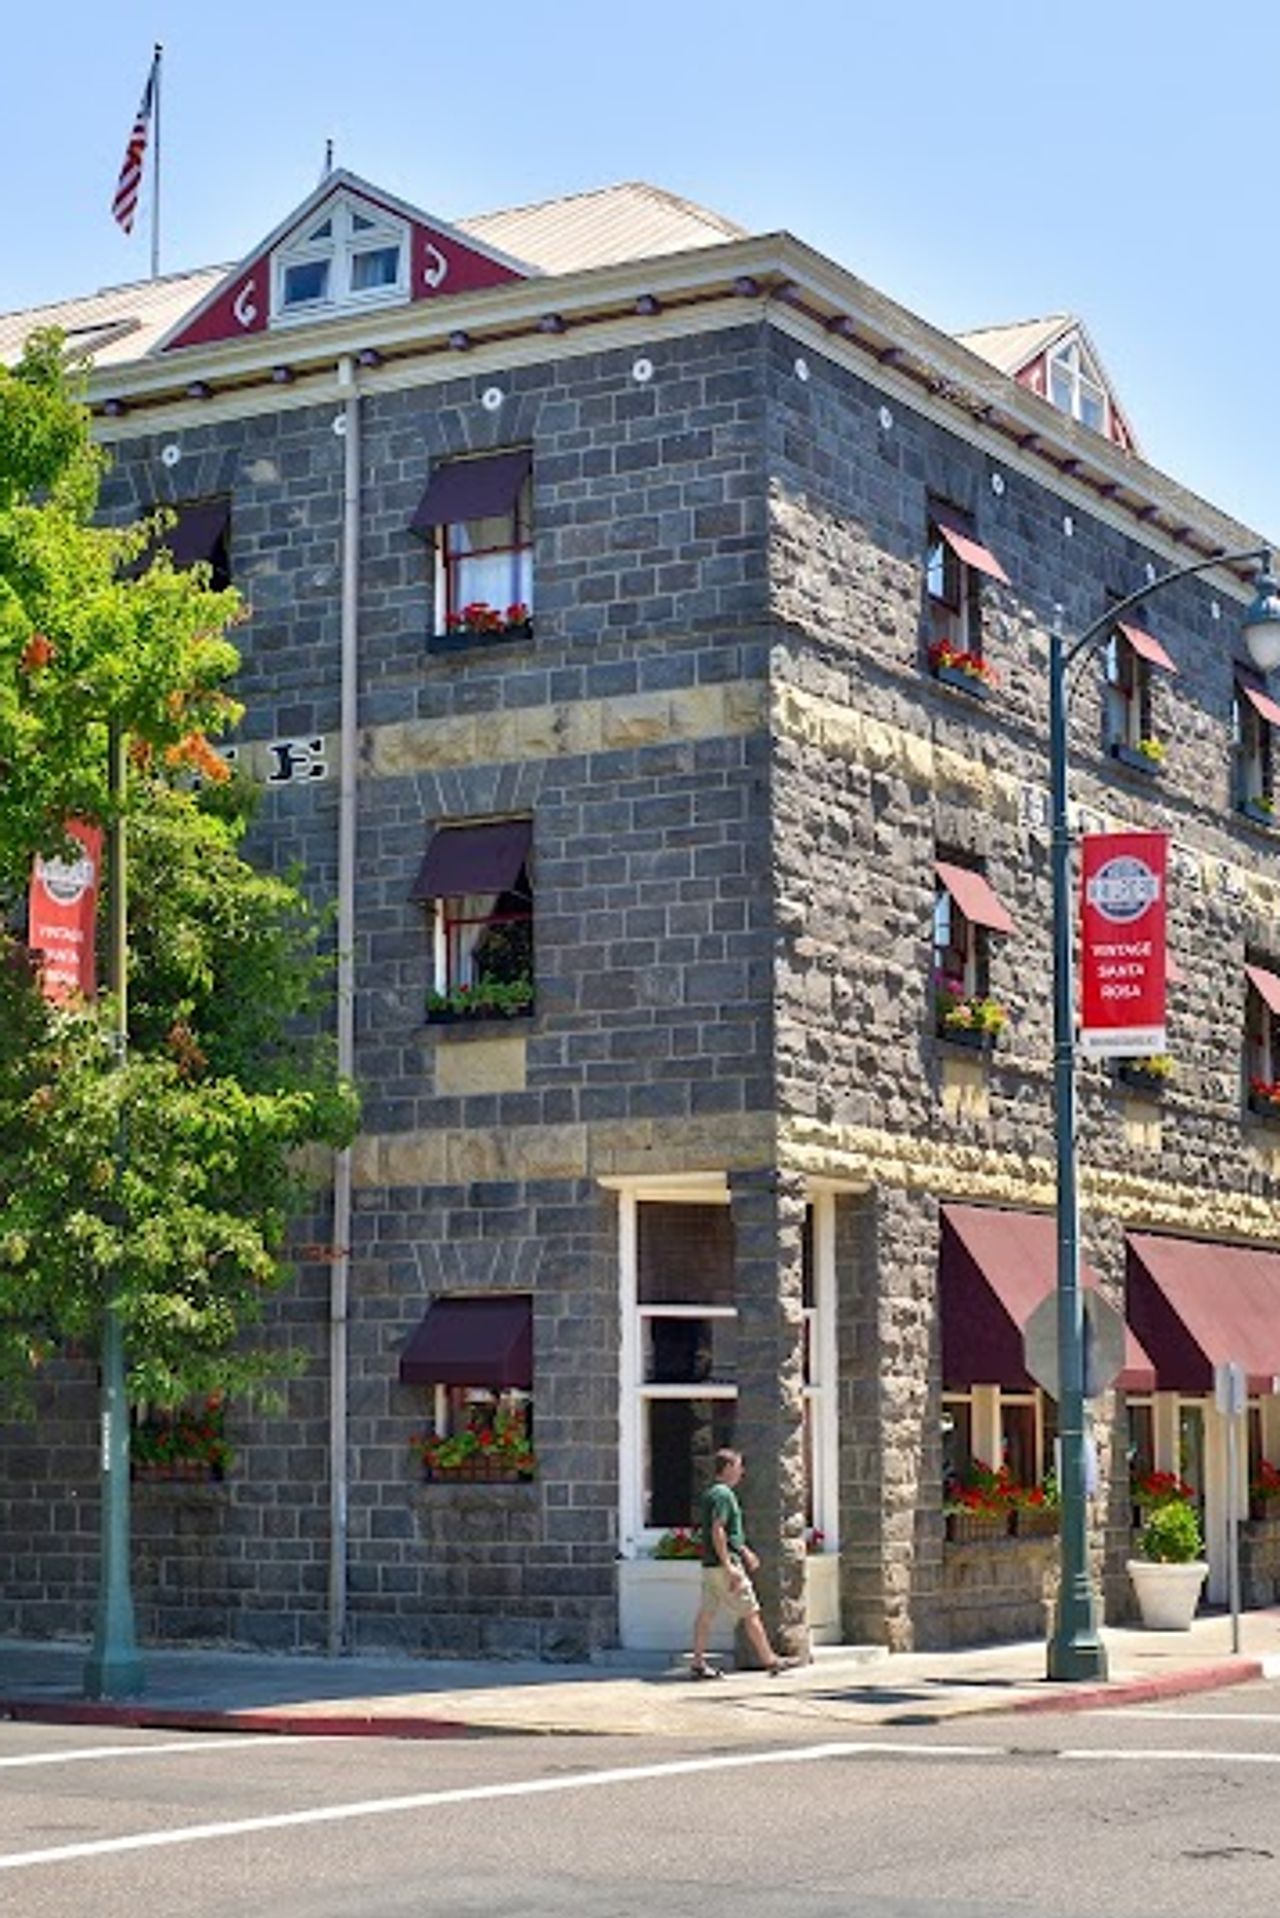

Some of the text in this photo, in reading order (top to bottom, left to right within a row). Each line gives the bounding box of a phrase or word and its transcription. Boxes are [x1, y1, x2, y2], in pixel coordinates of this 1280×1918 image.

[1090, 942, 1152, 957] VINTAGE
[1097, 963, 1145, 978] SANTA
[1100, 984, 1142, 1000] ROSA
